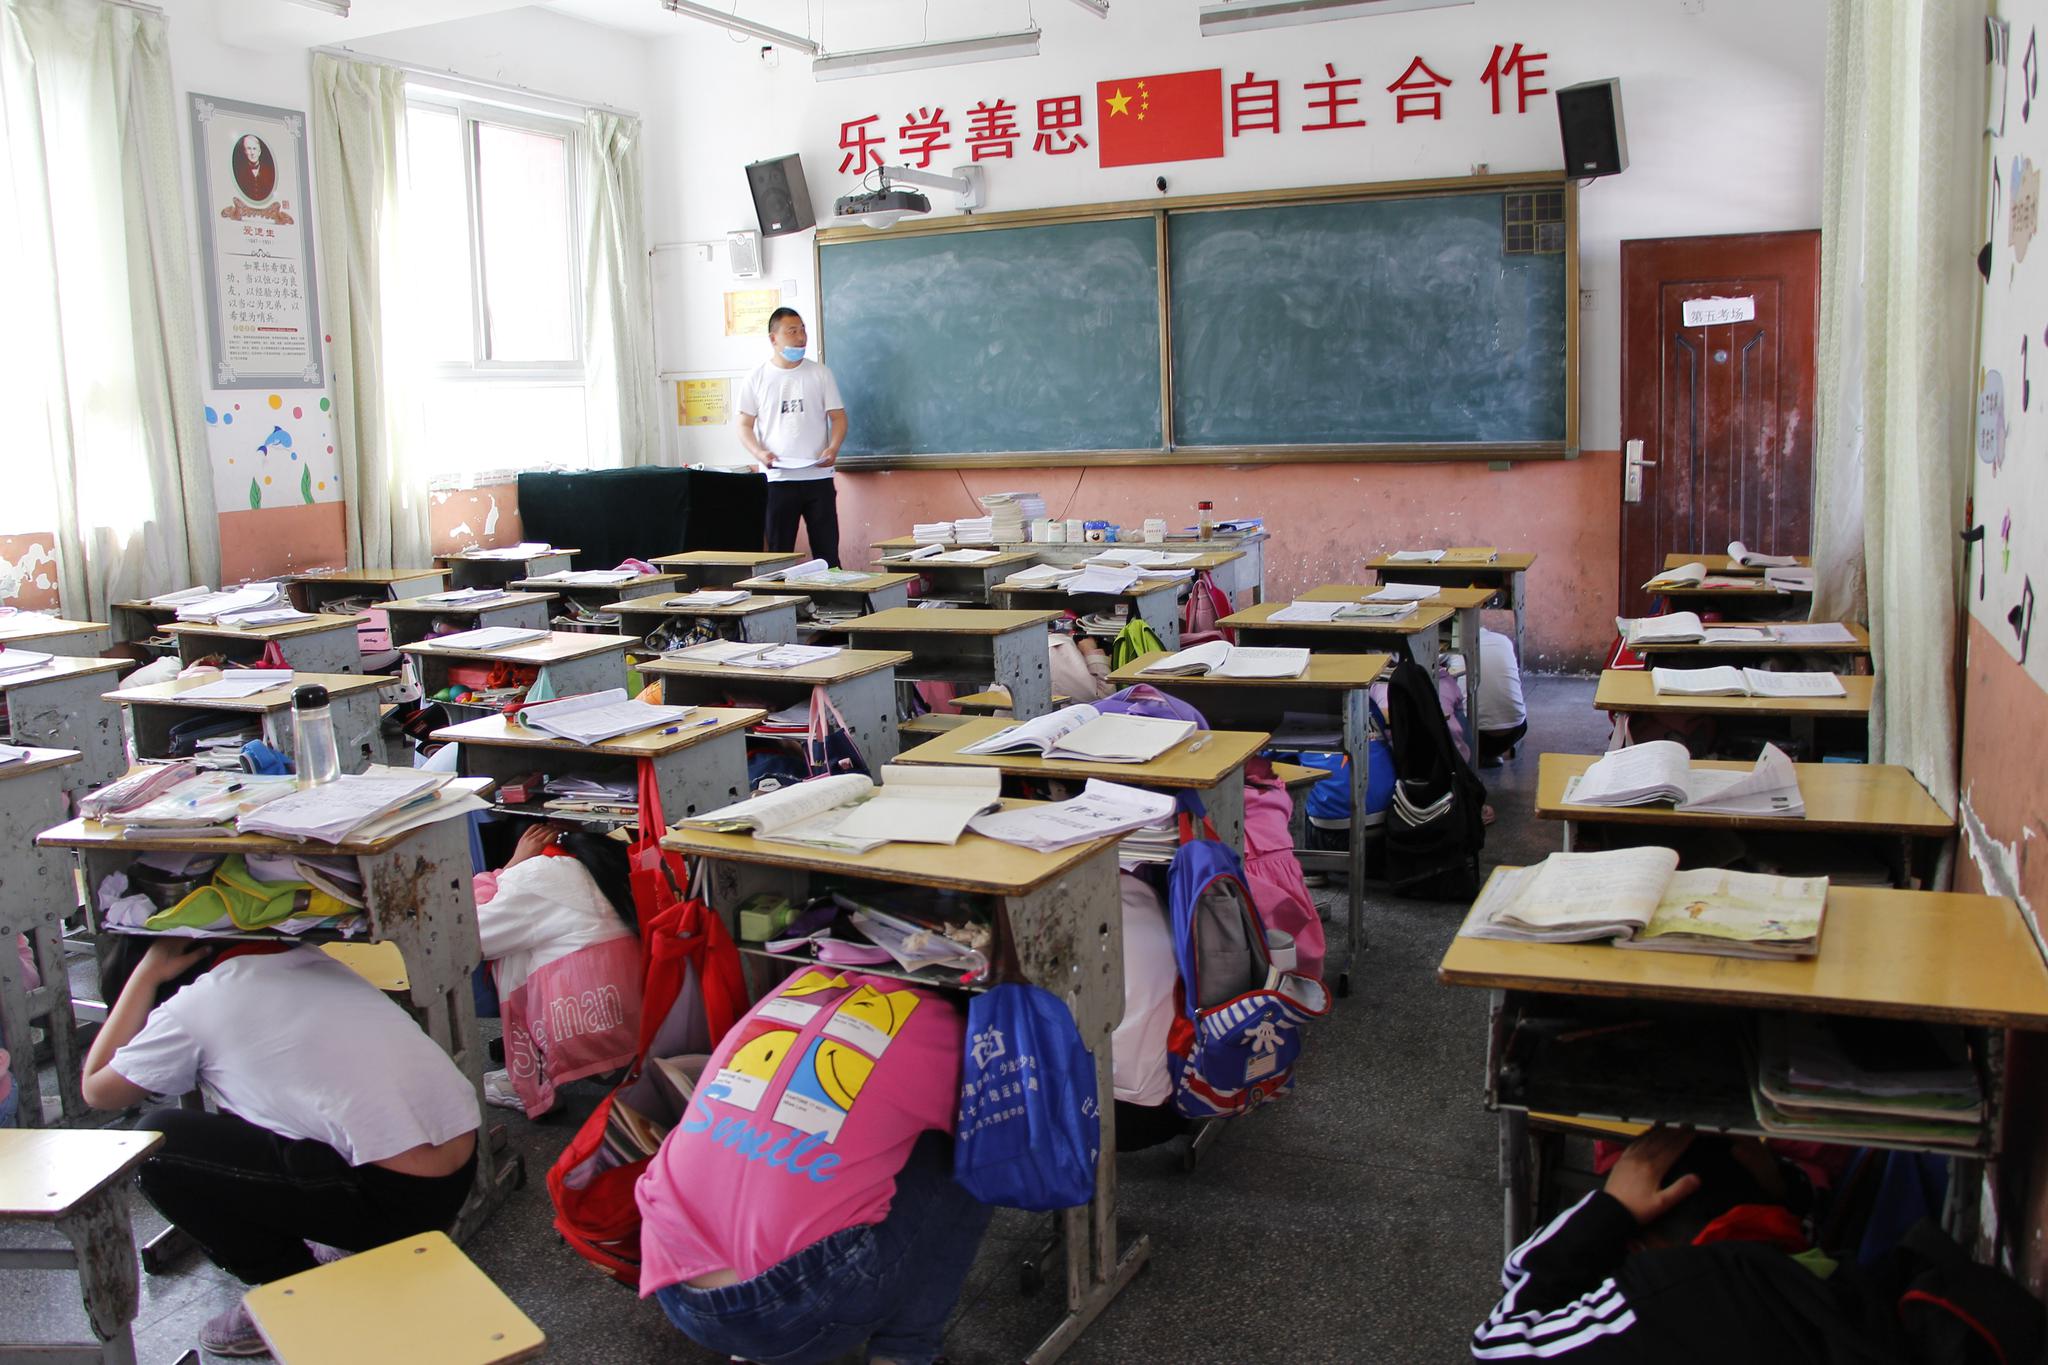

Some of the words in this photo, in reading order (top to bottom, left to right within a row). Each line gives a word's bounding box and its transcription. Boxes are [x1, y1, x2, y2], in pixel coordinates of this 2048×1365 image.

[838, 95, 1088, 175] 乐学善思
[1230, 43, 1548, 137] 自主合作
[243, 261, 296, 275] 如果你希望成
[1691, 307, 1744, 322] 第五考场
[681, 1083, 841, 1183] Smile
